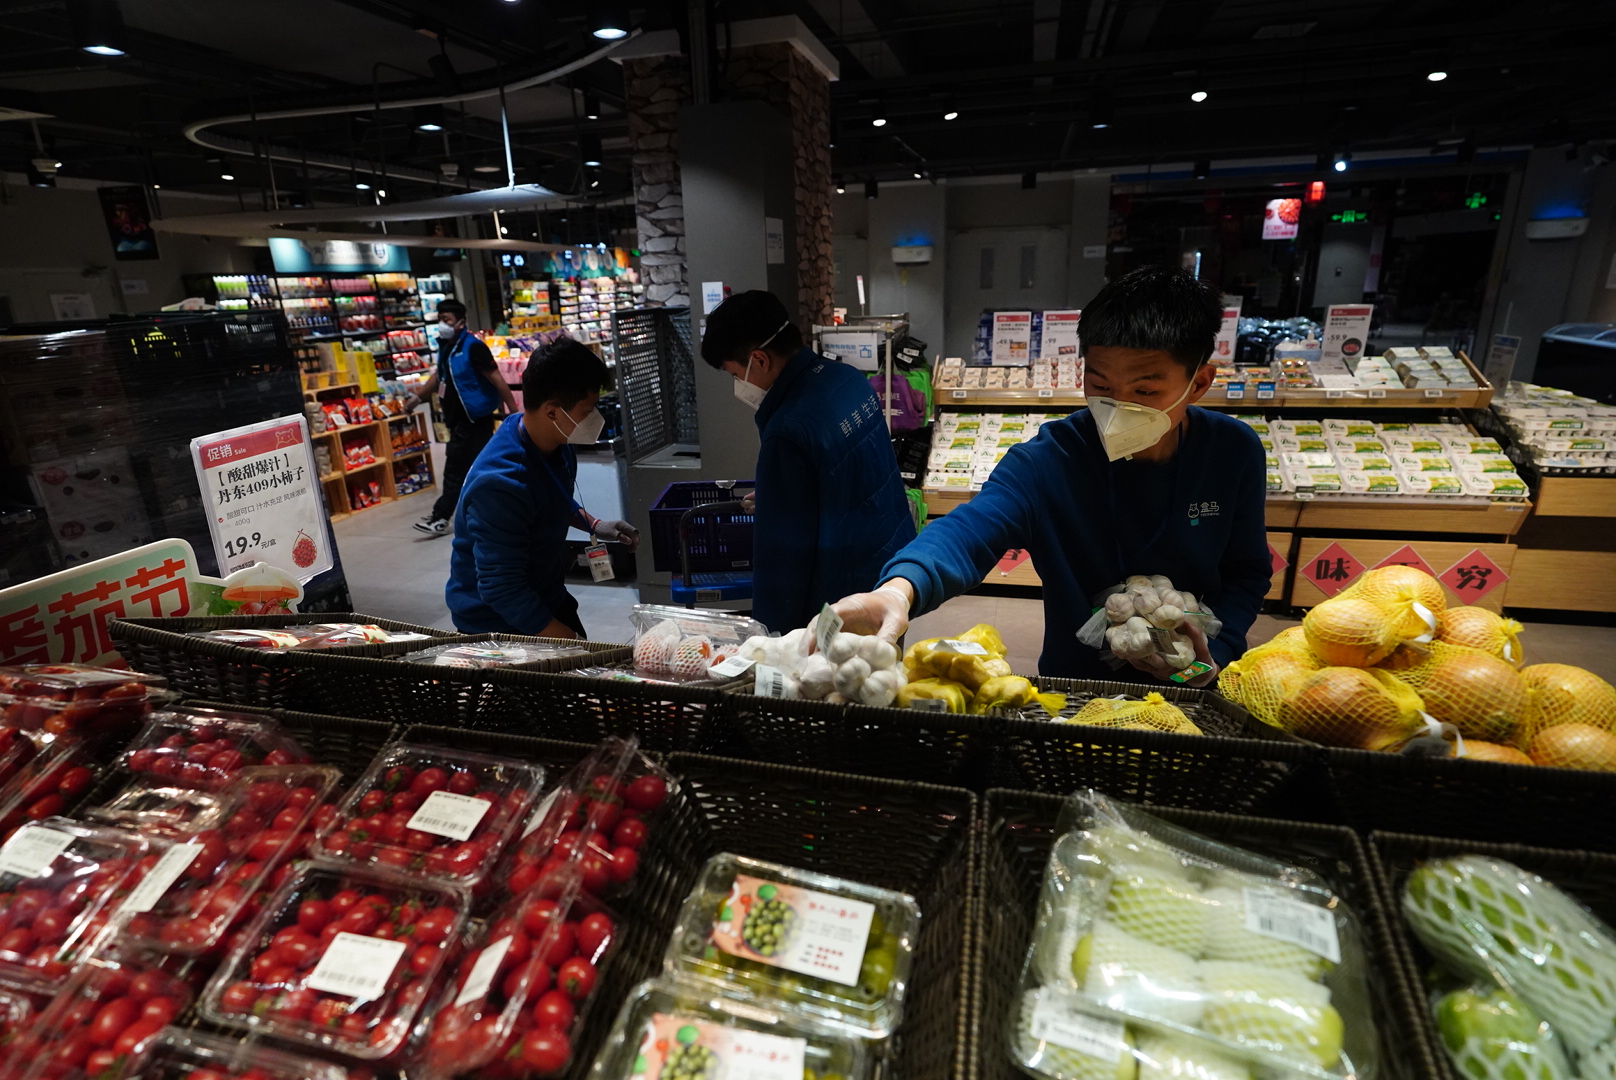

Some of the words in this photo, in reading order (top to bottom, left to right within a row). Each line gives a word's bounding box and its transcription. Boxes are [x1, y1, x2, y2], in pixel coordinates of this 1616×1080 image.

[839, 395, 880, 438] 鲜美生活
[207, 445, 232, 462] 促销
[234, 447, 247, 456] Sale
[218, 453, 290, 487] 【酸甜爆汁】
[217, 466, 305, 505] 丹东409小柿子
[226, 505, 255, 521] 酸甜可口
[256, 496, 284, 511] 汁水充足
[1199, 501, 1220, 513] 盒马
[234, 518, 251, 527] 400g
[224, 532, 262, 559] 19.9
[1315, 557, 1351, 582] 味
[1456, 564, 1493, 591] 穷
